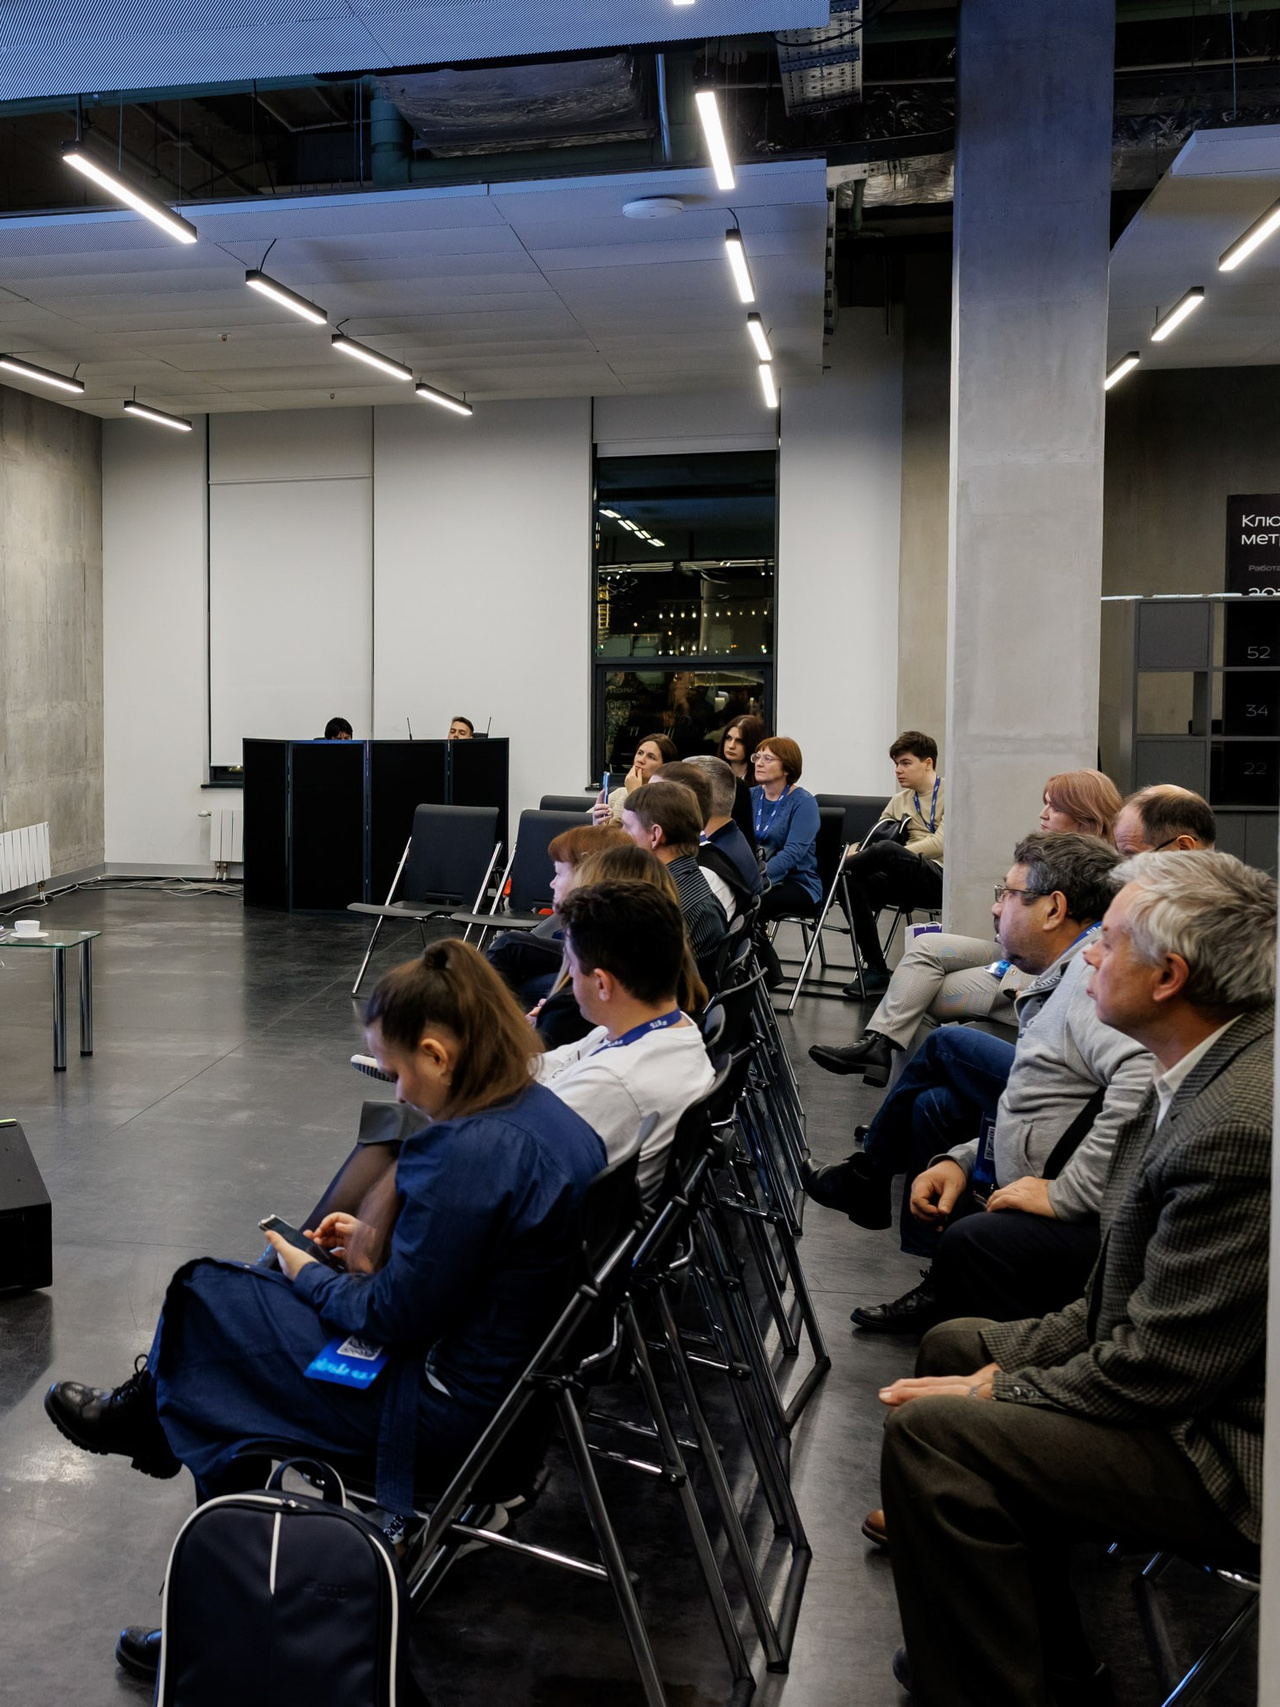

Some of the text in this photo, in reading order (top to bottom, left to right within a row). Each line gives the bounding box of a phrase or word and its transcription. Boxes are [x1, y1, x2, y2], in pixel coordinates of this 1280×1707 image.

[1241, 533, 1280, 546] мет
[1247, 646, 1271, 659] 52
[1246, 704, 1268, 717] 34
[1244, 762, 1267, 775] 22
